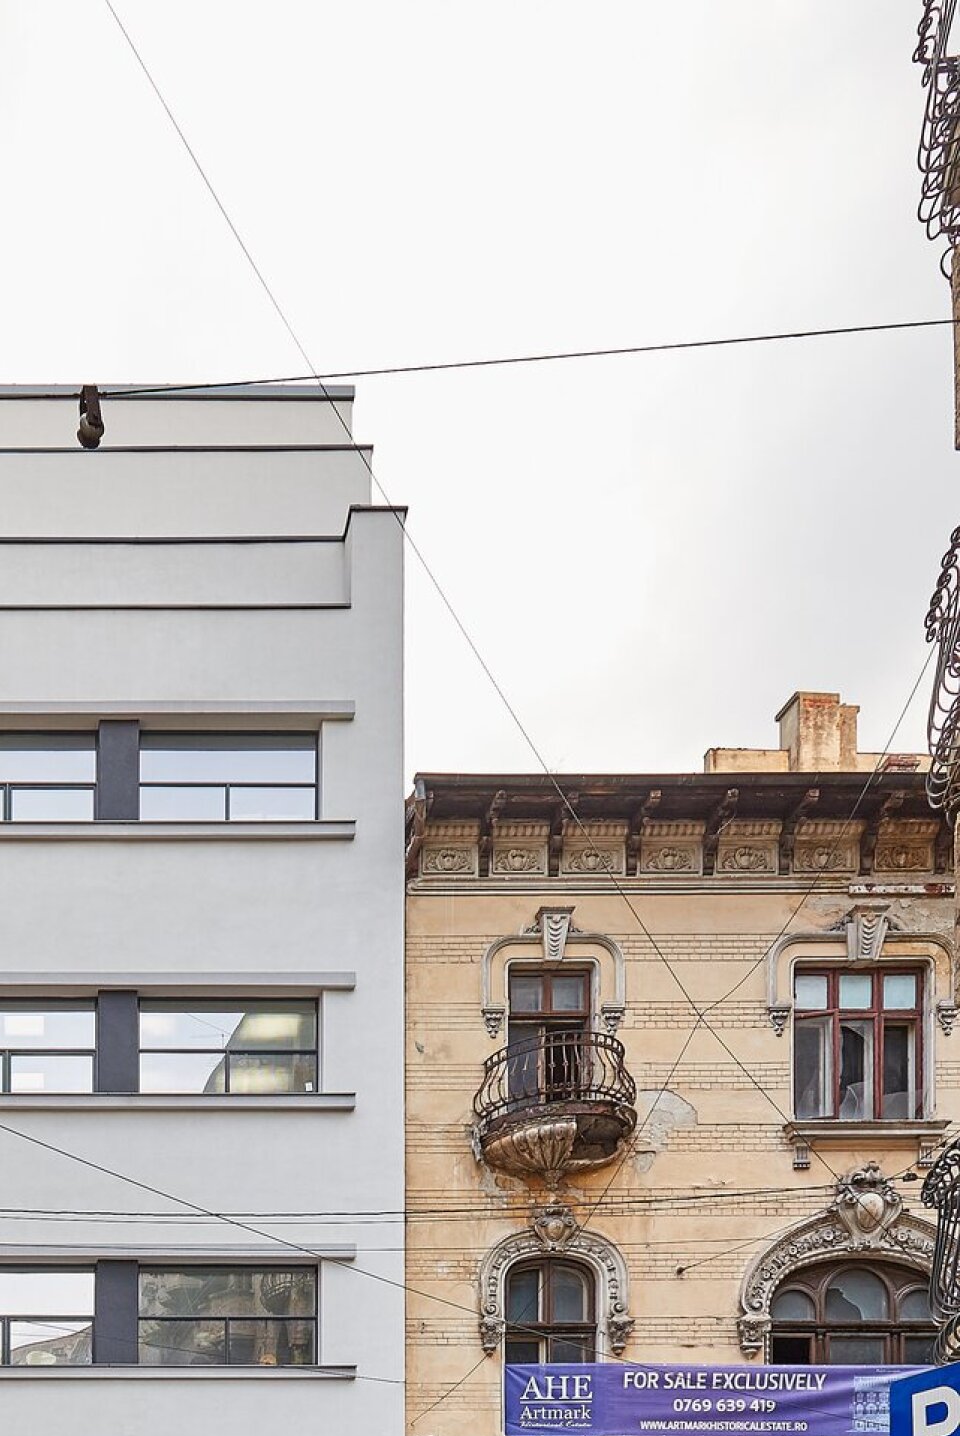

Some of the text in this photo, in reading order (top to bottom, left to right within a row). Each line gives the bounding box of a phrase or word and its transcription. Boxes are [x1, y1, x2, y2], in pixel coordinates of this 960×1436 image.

[520, 1375, 592, 1400] AHE
[624, 1372, 826, 1391] FOR SALE EXCLUSIVELY
[520, 1405, 592, 1420] Artmark
[673, 1399, 776, 1413] 0769 639 419
